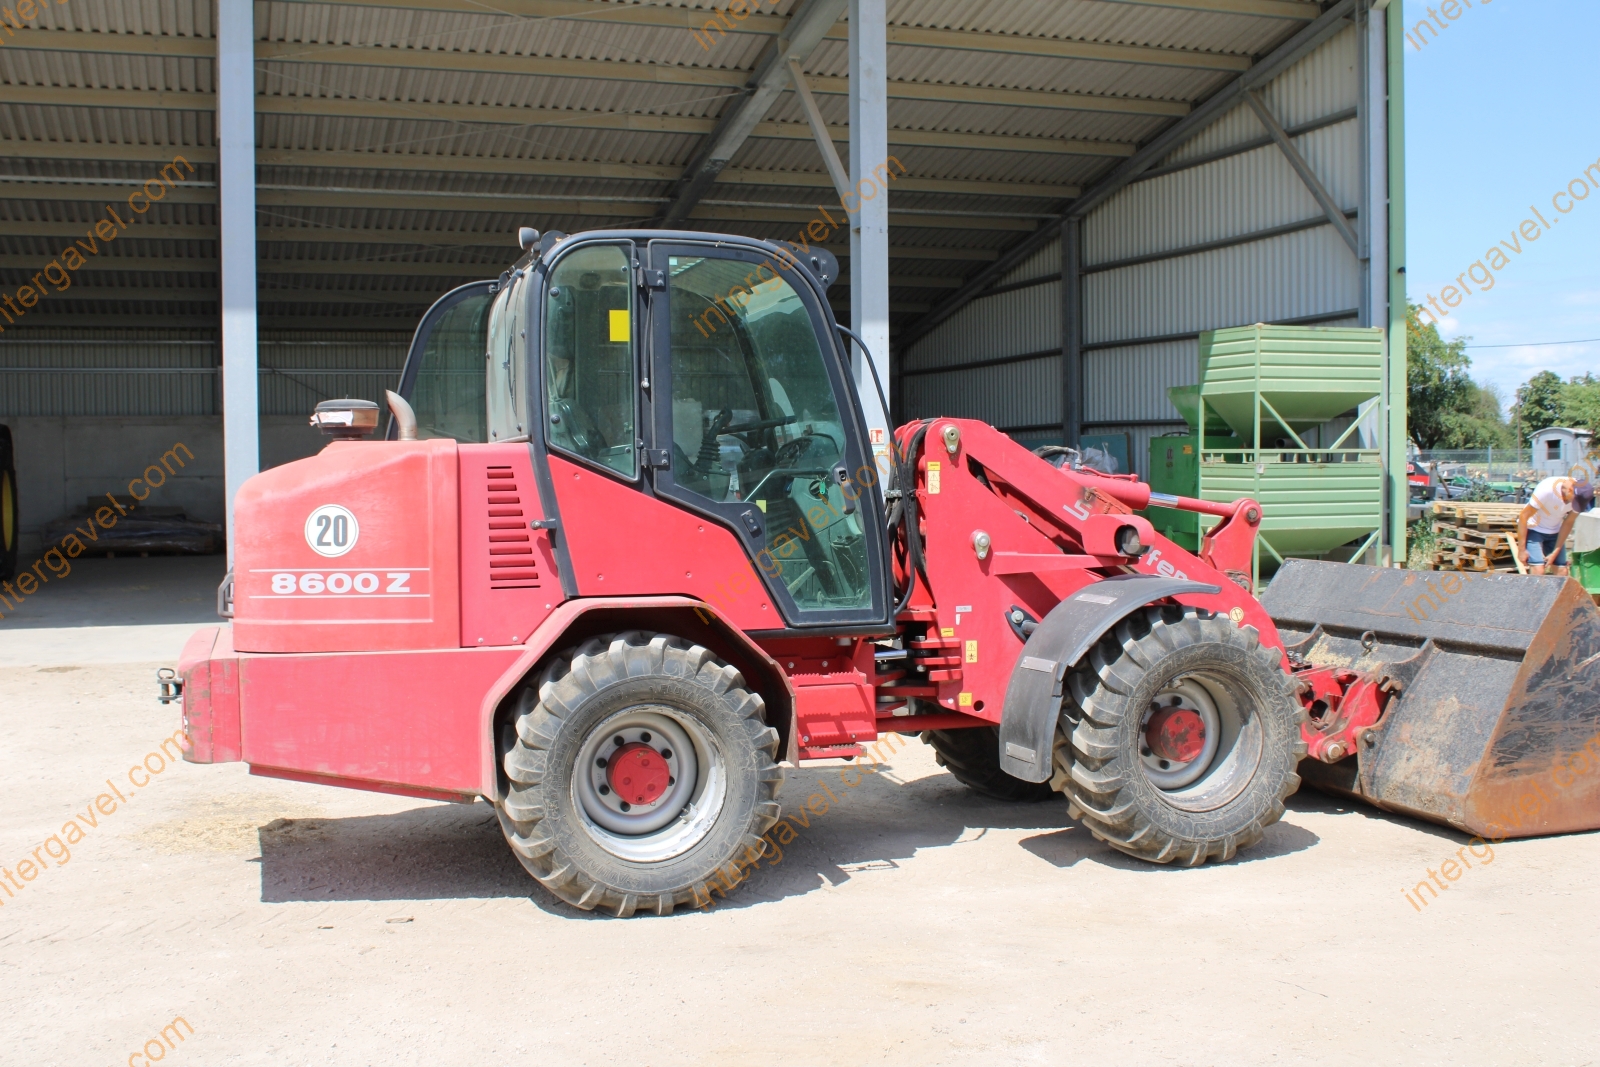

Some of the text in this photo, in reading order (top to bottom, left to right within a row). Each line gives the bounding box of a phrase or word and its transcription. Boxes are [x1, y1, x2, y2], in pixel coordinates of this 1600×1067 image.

[316, 514, 349, 547] 20
[271, 572, 411, 594] 8600 Z
